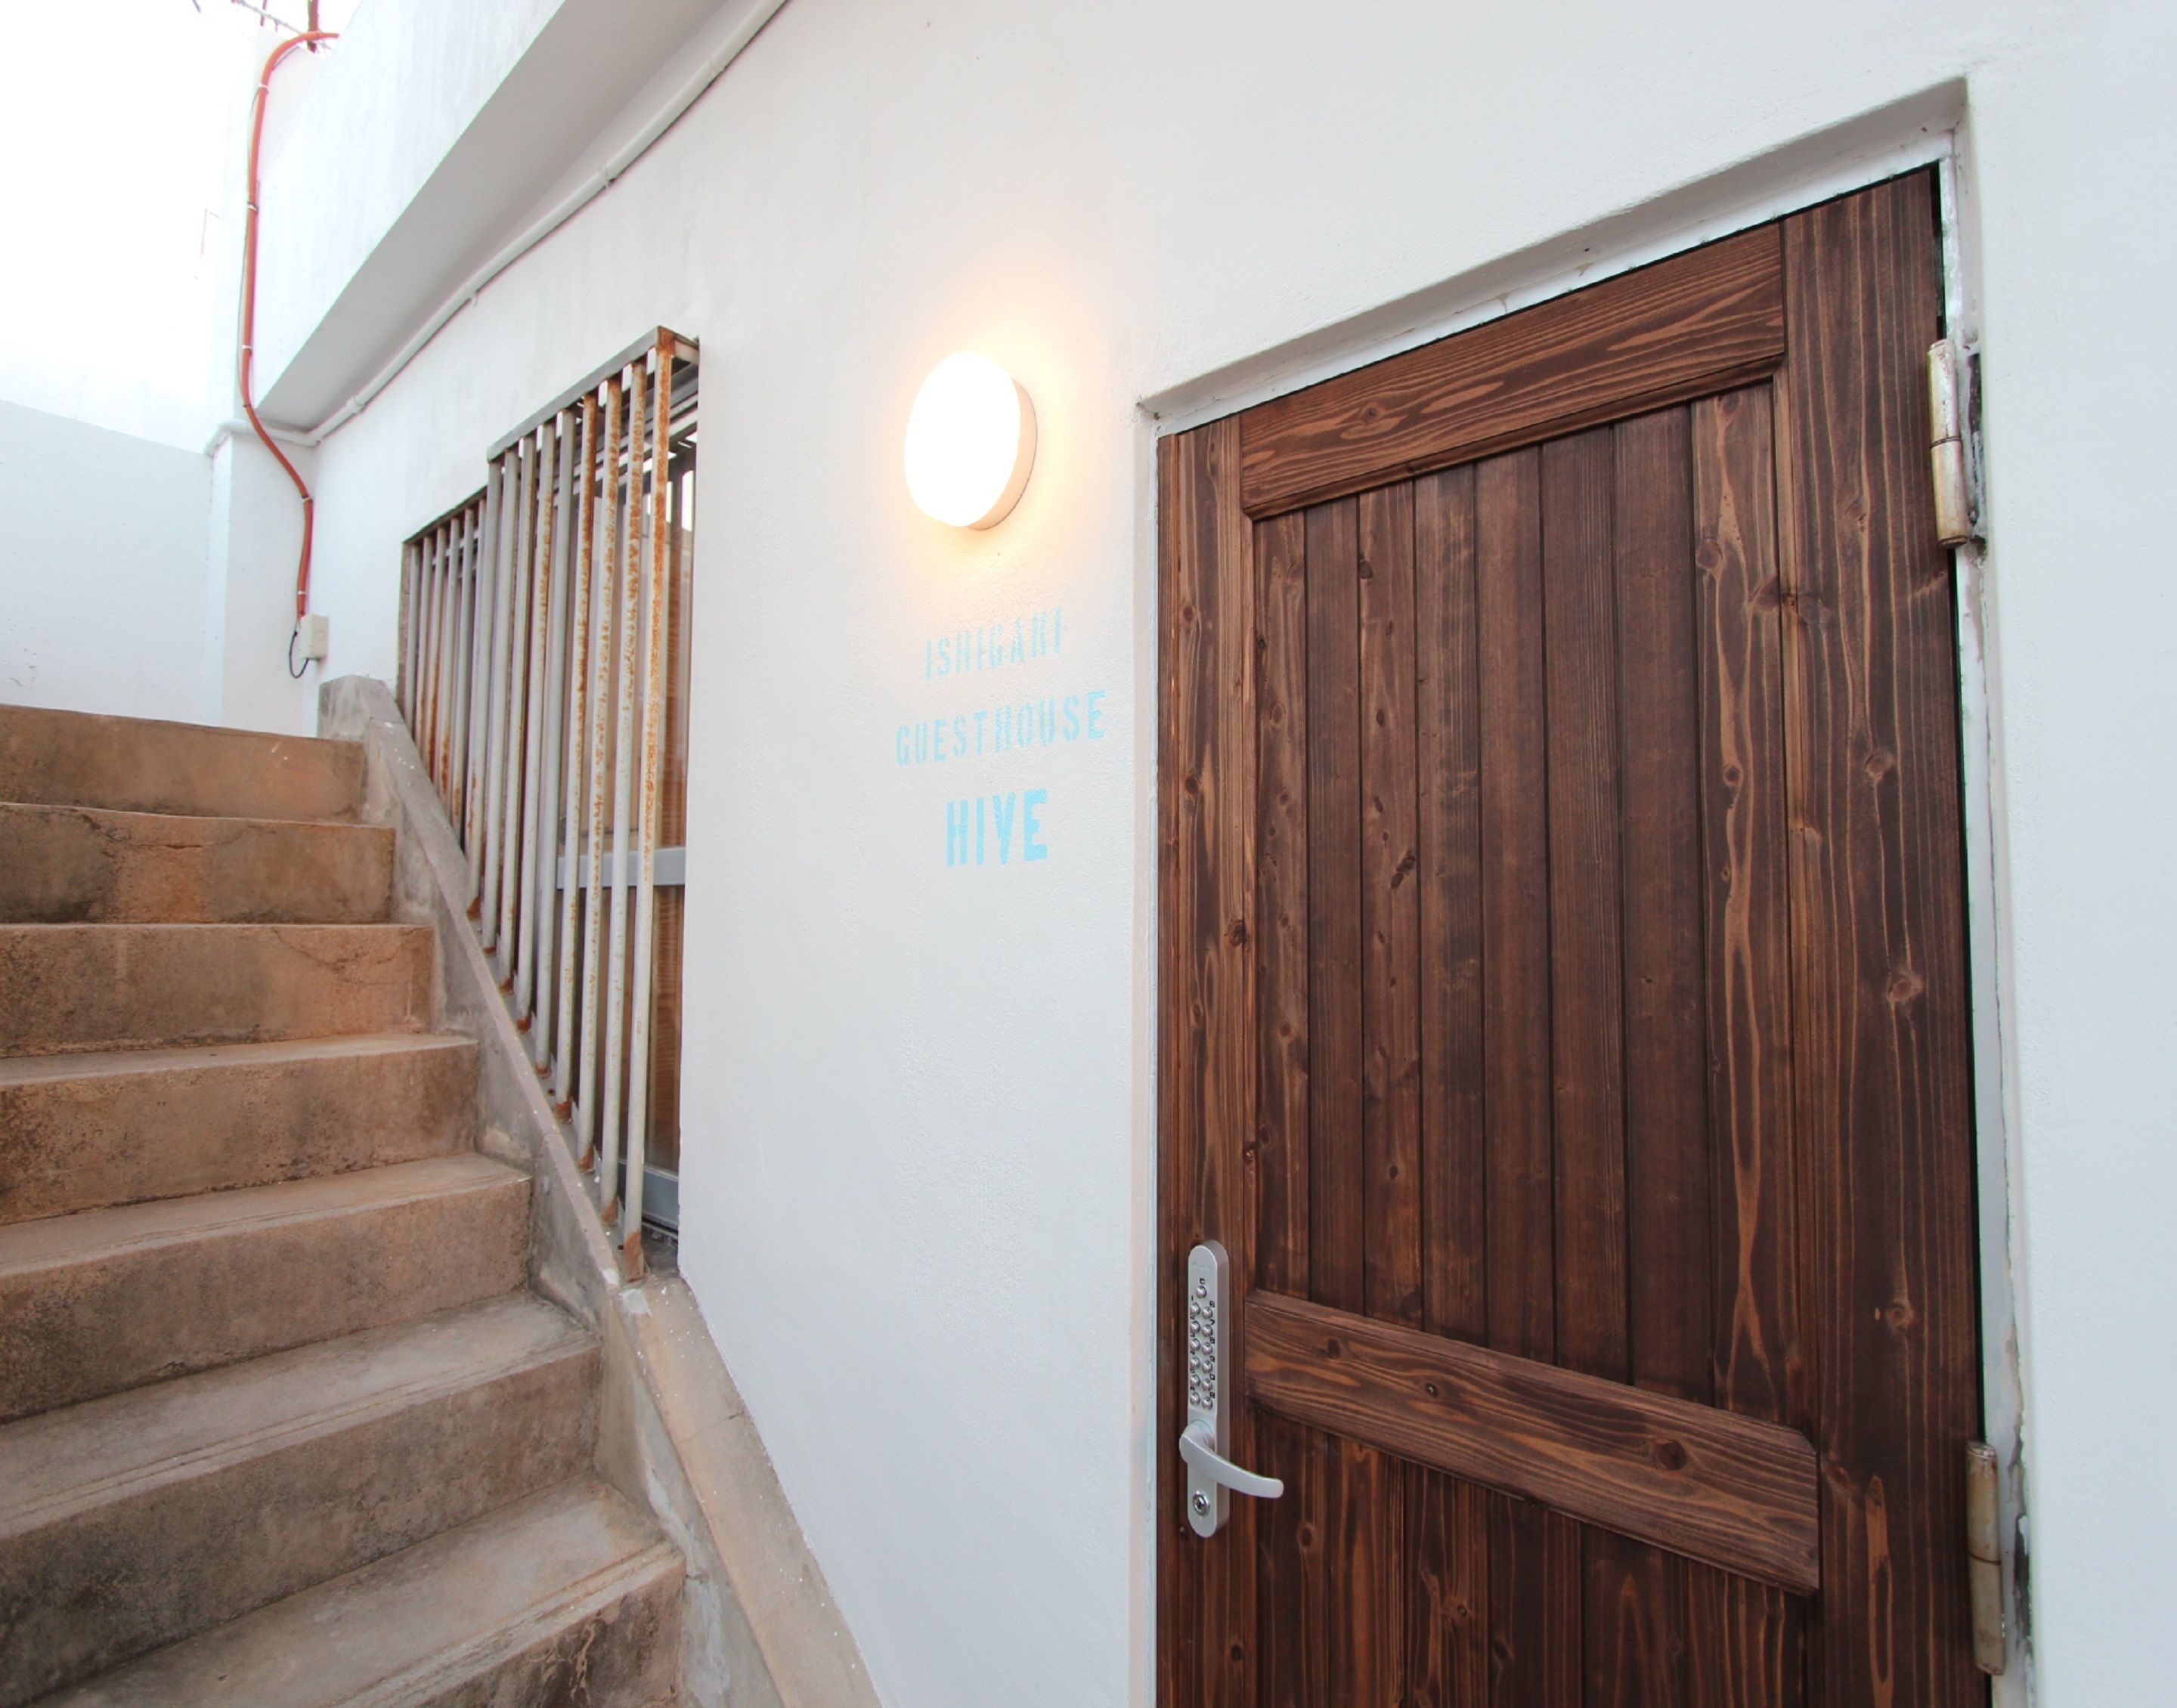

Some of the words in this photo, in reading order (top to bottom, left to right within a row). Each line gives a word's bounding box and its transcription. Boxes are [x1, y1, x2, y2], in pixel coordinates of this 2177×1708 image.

[924, 608, 1062, 681] ISHIGAKI
[896, 689, 1106, 766] GUESTHOUSE
[947, 788, 1048, 866] HIVE
